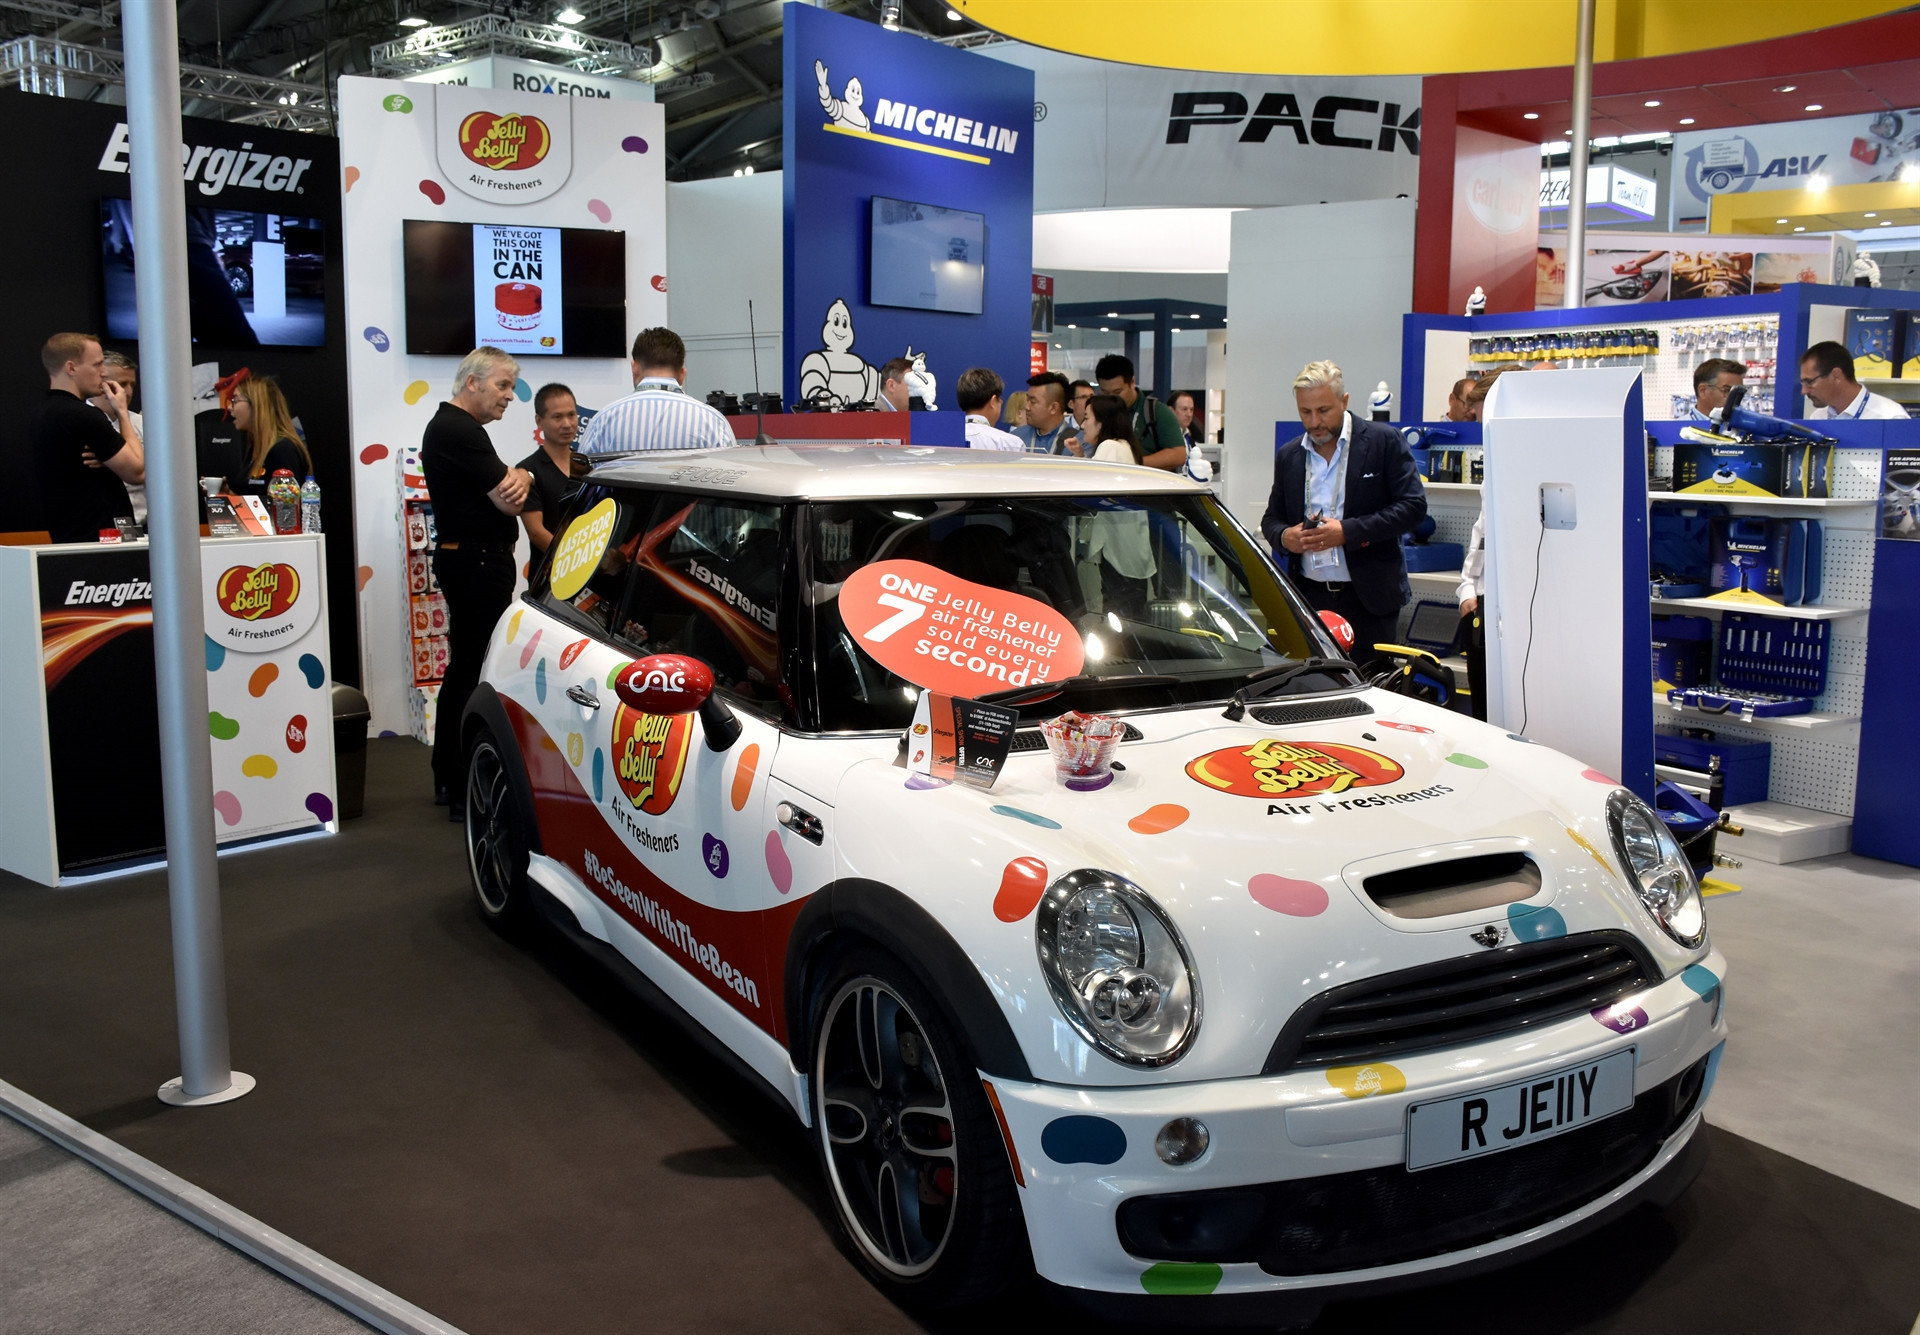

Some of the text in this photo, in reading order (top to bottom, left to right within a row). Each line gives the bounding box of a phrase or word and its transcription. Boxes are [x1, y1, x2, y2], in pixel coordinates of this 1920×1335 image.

[487, 113, 526, 143] Jelly
[874, 98, 1018, 154] MICHELIN
[473, 137, 522, 170] Belly
[469, 174, 543, 191] Air Fresheners
[493, 238, 542, 249] THIS ONE
[523, 231, 542, 240] GOT
[494, 249, 542, 262] IN THE
[493, 262, 542, 280] CAN
[558, 511, 612, 558] LASTS FOR
[552, 533, 607, 583] 30 DAYS
[243, 563, 279, 592] Jelly
[879, 573, 938, 603] ONE
[230, 591, 272, 621] Belly
[864, 593, 926, 642] 7
[938, 593, 1062, 647] Jelly Belly
[227, 622, 295, 639] Air Fresheners
[931, 607, 1056, 658] air freshener
[926, 625, 1051, 679] sold every
[934, 728, 954, 737] Energizer
[620, 737, 657, 798] Belly
[1241, 739, 1342, 768] Jelly
[1253, 758, 1360, 793] Belly
[1267, 784, 1454, 815] Air Fresheners
[611, 796, 679, 853] Air Fresheners
[584, 848, 760, 1008] #BeSeenWithTheBean
[1354, 1080, 1381, 1096] Belly
[1357, 1068, 1381, 1084] Jelly
[1461, 1098, 1488, 1151] R
